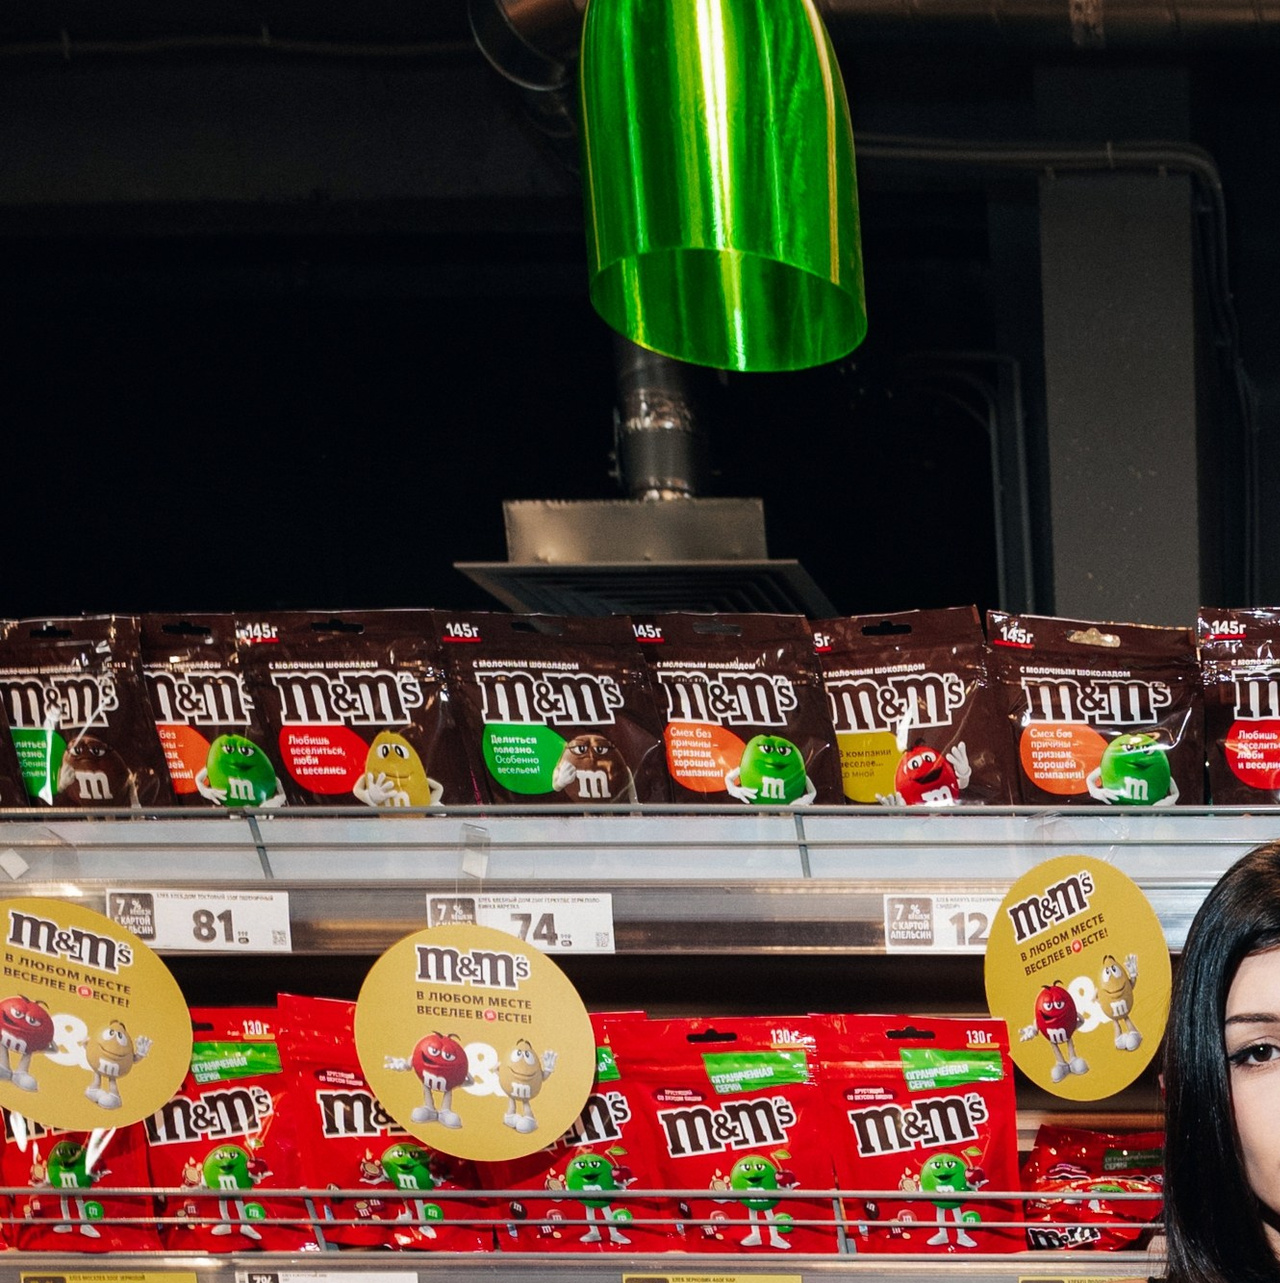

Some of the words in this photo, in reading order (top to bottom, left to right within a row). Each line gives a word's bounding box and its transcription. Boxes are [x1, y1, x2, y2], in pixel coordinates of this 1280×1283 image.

[446, 623, 478, 638] 145г
[1001, 628, 1033, 643] 145г
[1212, 621, 1246, 635] 145г
[271, 671, 423, 726] m&m's
[475, 672, 624, 725] m&m's
[658, 671, 797, 726] m&m's
[1021, 677, 1172, 724] m&m's
[670, 727, 693, 738] Смех
[695, 727, 712, 739] без
[898, 919, 930, 929] КАРТОЙ
[1007, 870, 1095, 945] m&m's
[7, 909, 133, 974] m&m's
[192, 909, 234, 943] 81
[510, 913, 558, 946] 74
[891, 930, 931, 940] АПЕЛЬСИН
[1020, 952, 1027, 962] В
[1029, 931, 1070, 958] ЛЮБОМ
[1071, 913, 1105, 937] МЕСТЕ
[4, 967, 65, 990] ВЕСЕЛЕЕ
[5, 953, 13, 964] В
[19, 957, 80, 980] ЛЮБОМ
[84, 974, 131, 995] МЕСТЕ
[415, 944, 531, 990] m&m's
[1025, 949, 1066, 976] ВЕСЕЛЕЕ
[416, 991, 424, 1000] В
[428, 992, 484, 1005] ЛЮБОМ
[488, 997, 532, 1009] МЕСТЕ
[417, 1005, 473, 1018] ВЕСЕЛЕЕ
[656, 1096, 797, 1158] m&m's
[847, 1092, 989, 1158] m&m's
